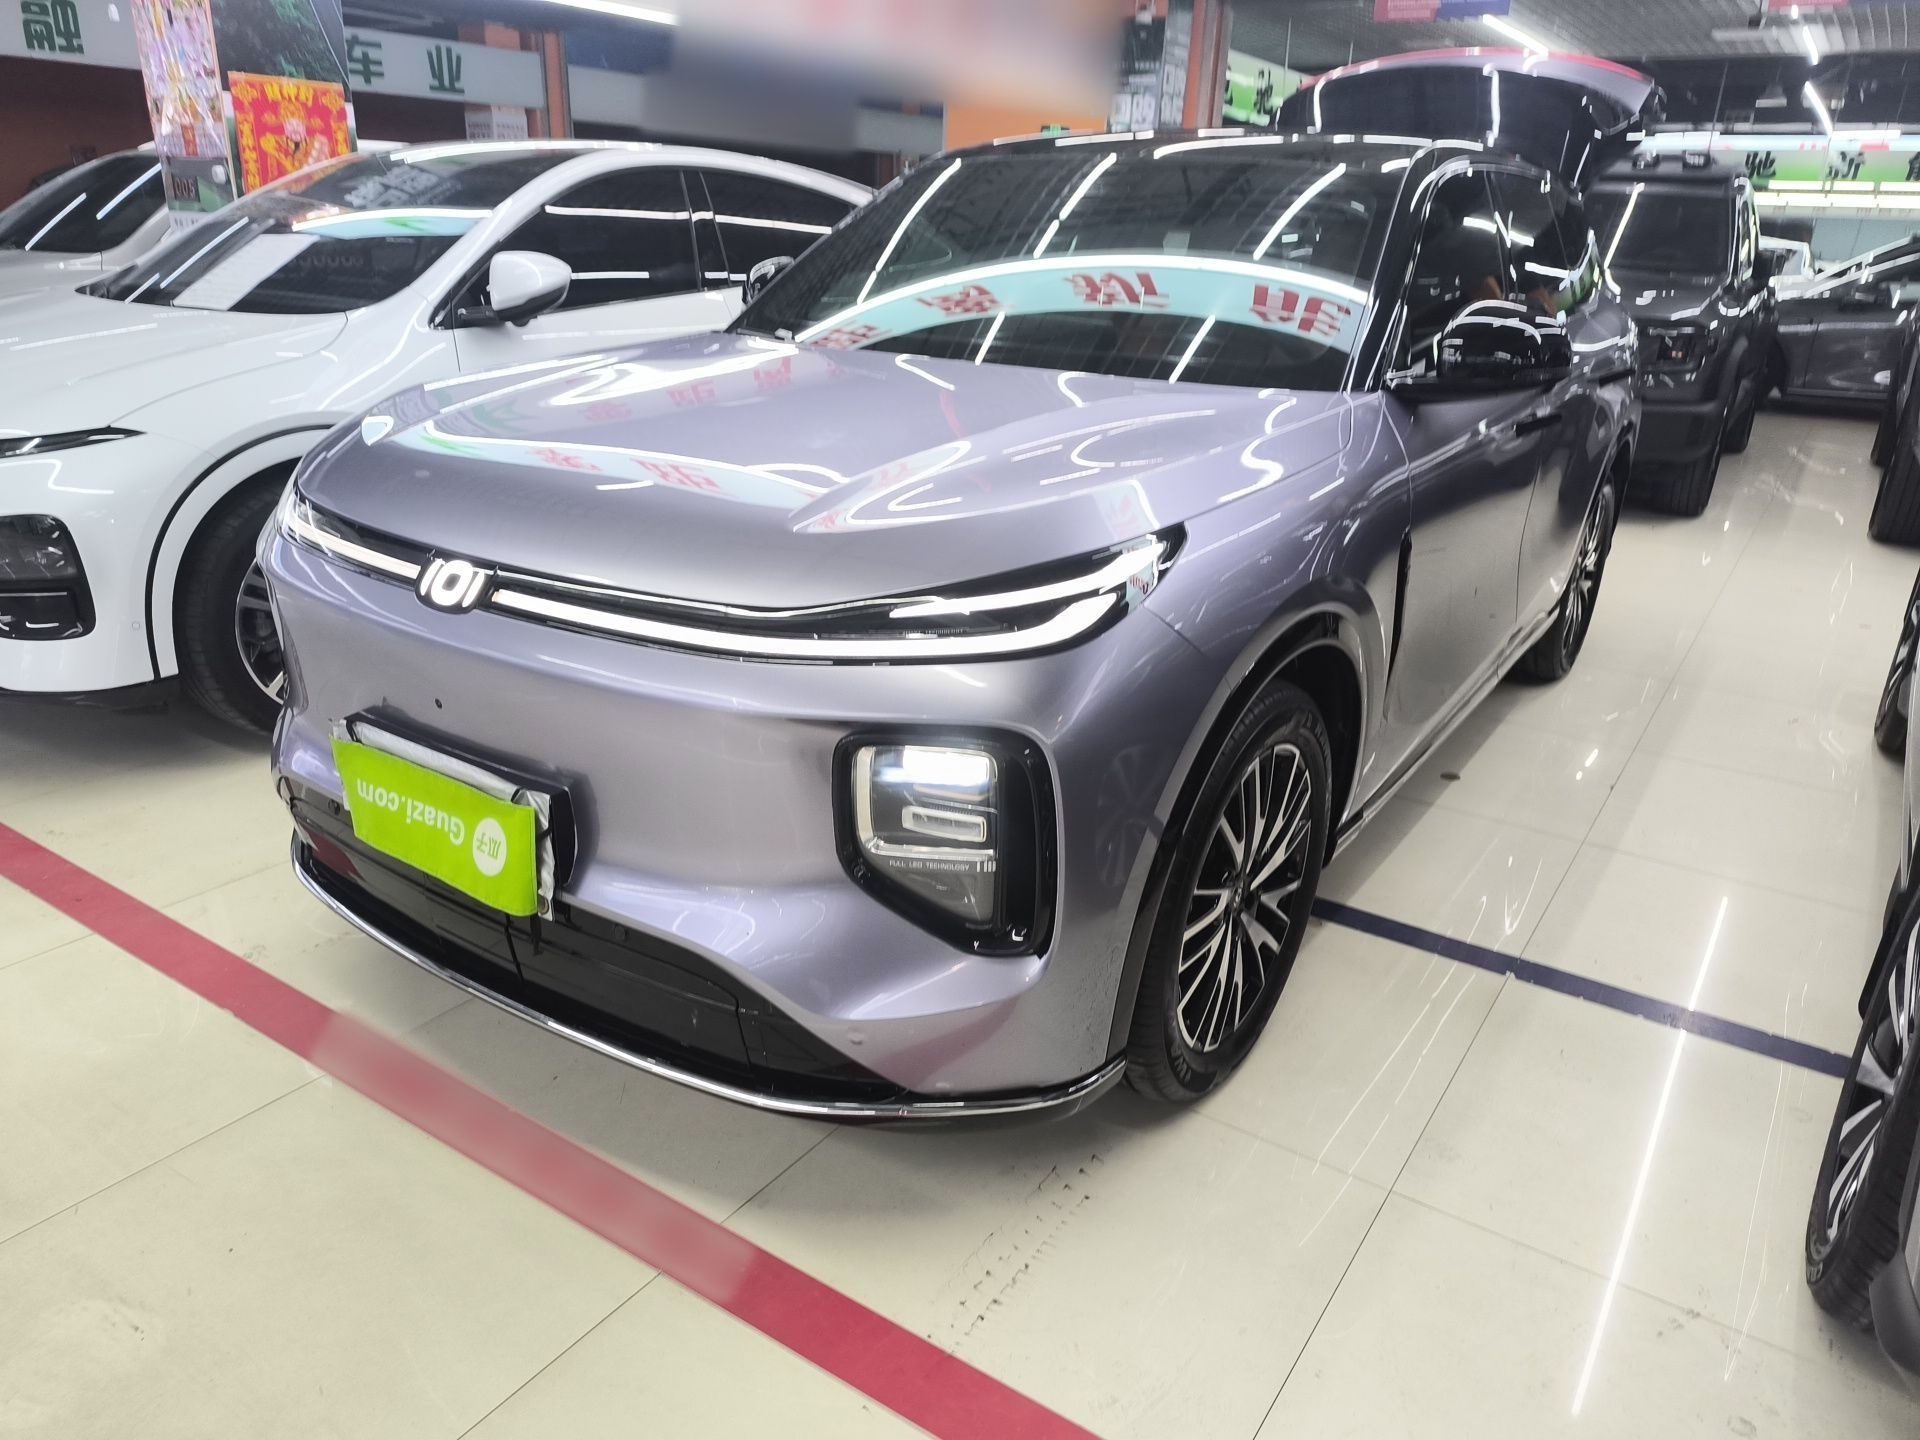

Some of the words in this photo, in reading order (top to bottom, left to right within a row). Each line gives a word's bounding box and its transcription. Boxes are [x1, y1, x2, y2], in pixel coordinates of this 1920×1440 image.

[356, 778, 465, 846] Guazi.com
[476, 832, 501, 860] 瓜子
[889, 860, 905, 868] FULL
[909, 860, 923, 869] LED
[926, 861, 970, 871] TECHNOLOGY
